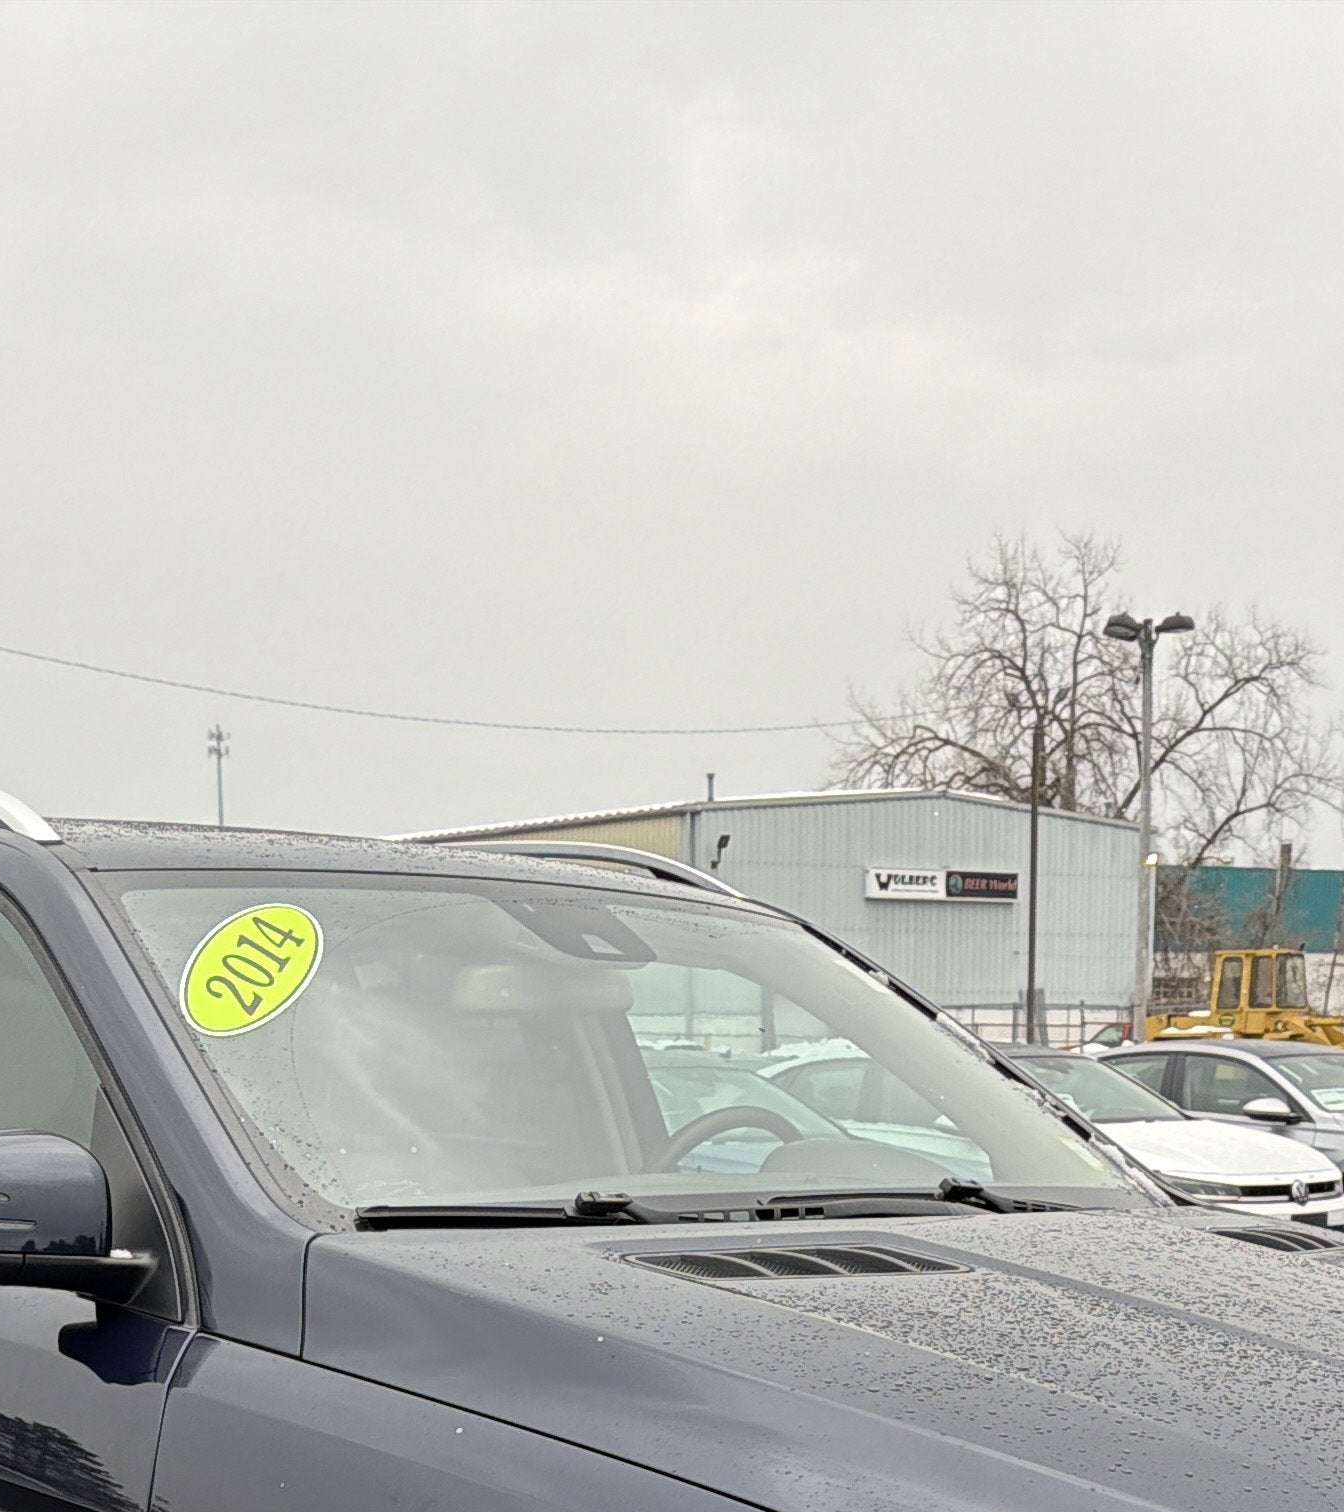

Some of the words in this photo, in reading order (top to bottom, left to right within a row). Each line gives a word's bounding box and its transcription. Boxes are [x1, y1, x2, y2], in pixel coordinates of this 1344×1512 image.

[964, 877, 987, 890] BEER
[989, 879, 1018, 891] World
[205, 916, 305, 1017] 2014
